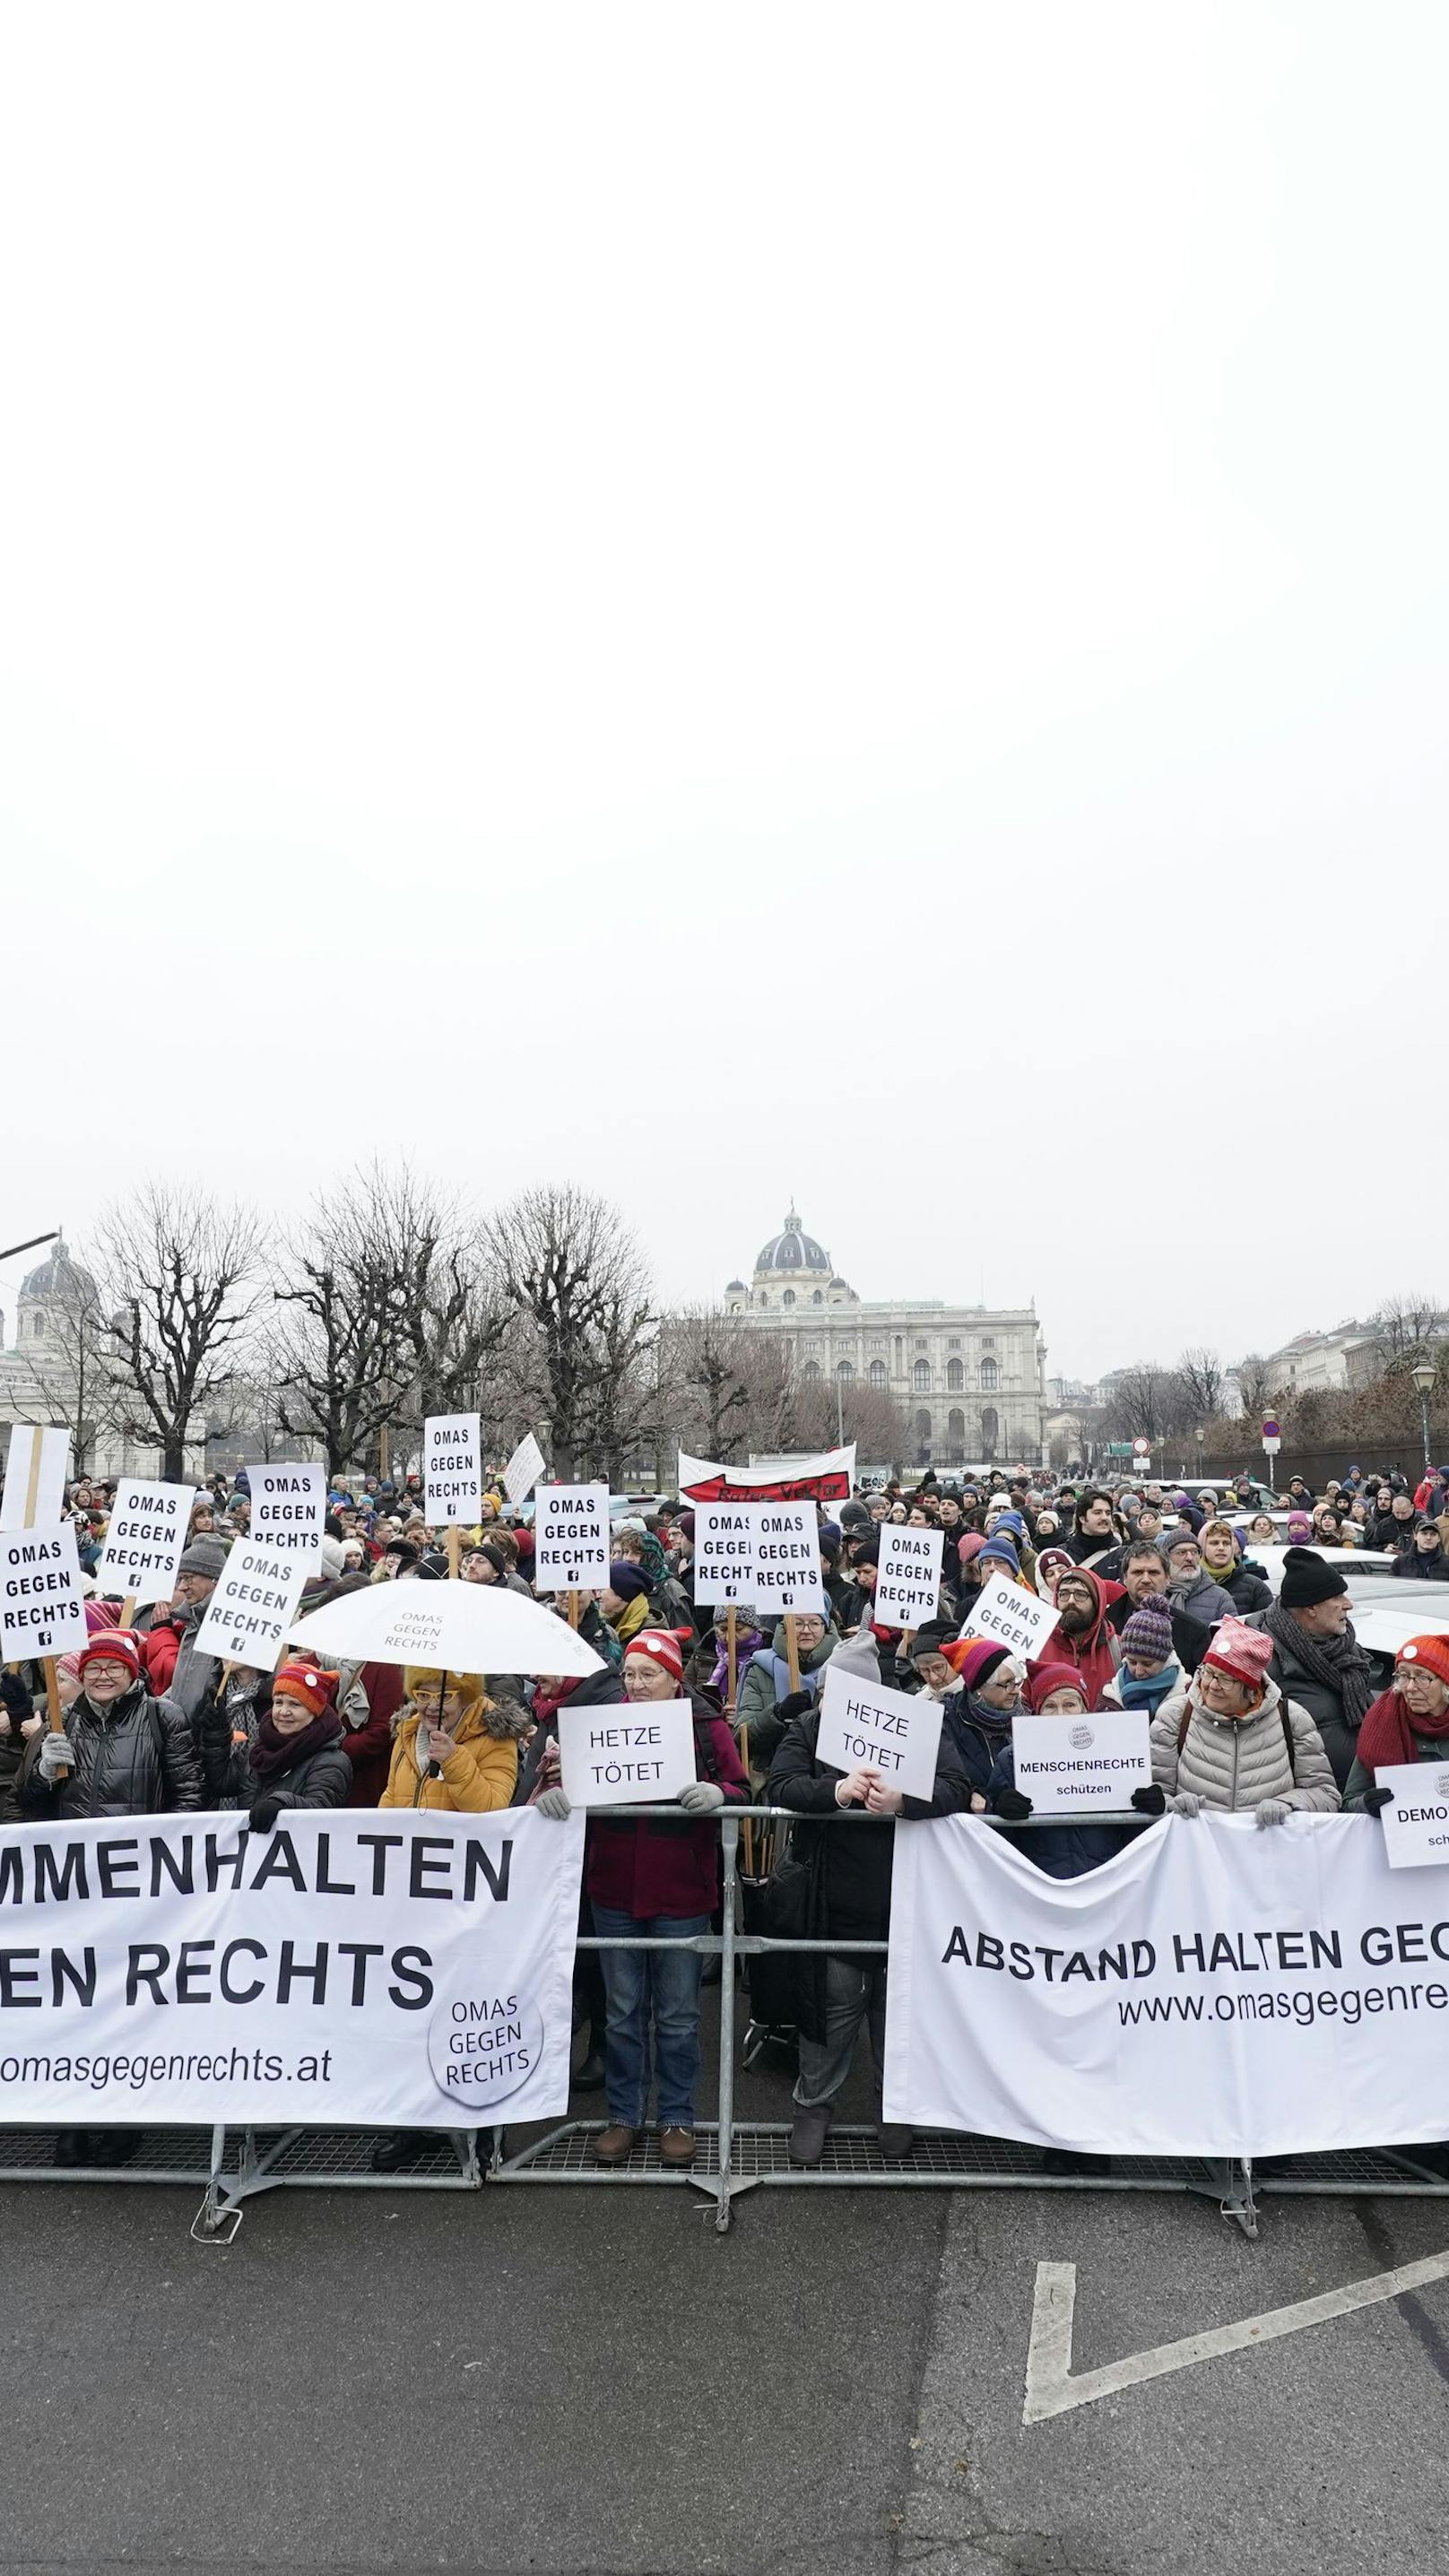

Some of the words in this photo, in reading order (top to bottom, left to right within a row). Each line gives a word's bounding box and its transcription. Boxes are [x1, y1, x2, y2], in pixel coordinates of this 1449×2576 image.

[434, 1428, 469, 1445] OMAS
[430, 1455, 473, 1472] GEGEN
[264, 1477, 311, 1493] OMAS
[428, 1481, 477, 1498] RECHTS
[128, 1495, 177, 1515] OMAS
[259, 1505, 316, 1521] GEGEN
[549, 1498, 595, 1514] OMAS
[117, 1522, 177, 1543] GEGEN
[544, 1523, 600, 1540] GEGEN
[760, 1516, 803, 1533] OMAS
[8, 1540, 62, 1566] OMAS
[540, 1548, 605, 1565] RECHTS
[759, 1543, 811, 1560] GEGEN
[891, 1539, 931, 1557] OMAS
[105, 1548, 175, 1572] RECHTS
[242, 1556, 292, 1582] OMAS
[756, 1570, 818, 1586] RECHTS
[885, 1562, 933, 1582] GEGEN
[5, 1570, 71, 1598] GEGEN
[226, 1581, 288, 1610] GEGEN
[879, 1585, 934, 1607] RECHTS
[4, 1600, 80, 1629] RECHTS
[402, 1612, 444, 1624] OMAS
[996, 1592, 1041, 1626] OMAS
[209, 1607, 282, 1640] RECHTS
[394, 1624, 441, 1636] GEGEN
[980, 1609, 1034, 1650] GEGEN
[384, 1635, 438, 1651] RECHTS
[846, 1699, 910, 1738] HETZE
[590, 1726, 662, 1748] HETZE
[843, 1732, 906, 1771] TÖTET
[590, 1761, 664, 1784] TÖTET
[1020, 1757, 1145, 1774] MENSCHENRECHTE
[1056, 1782, 1112, 1795] schützen
[941, 1925, 1156, 1982] ABSTAND
[1172, 1930, 1342, 1973] HALTEN
[0, 1947, 97, 2008] EN
[126, 1938, 434, 2010] RECHTS
[451, 1995, 517, 2023] OMAS
[1117, 1983, 1449, 2026] www.omasgegenre
[449, 2021, 522, 2054] GEGEN
[0, 2047, 333, 2090] omasgegenrechts.at
[447, 2049, 530, 2086] RECHTS
